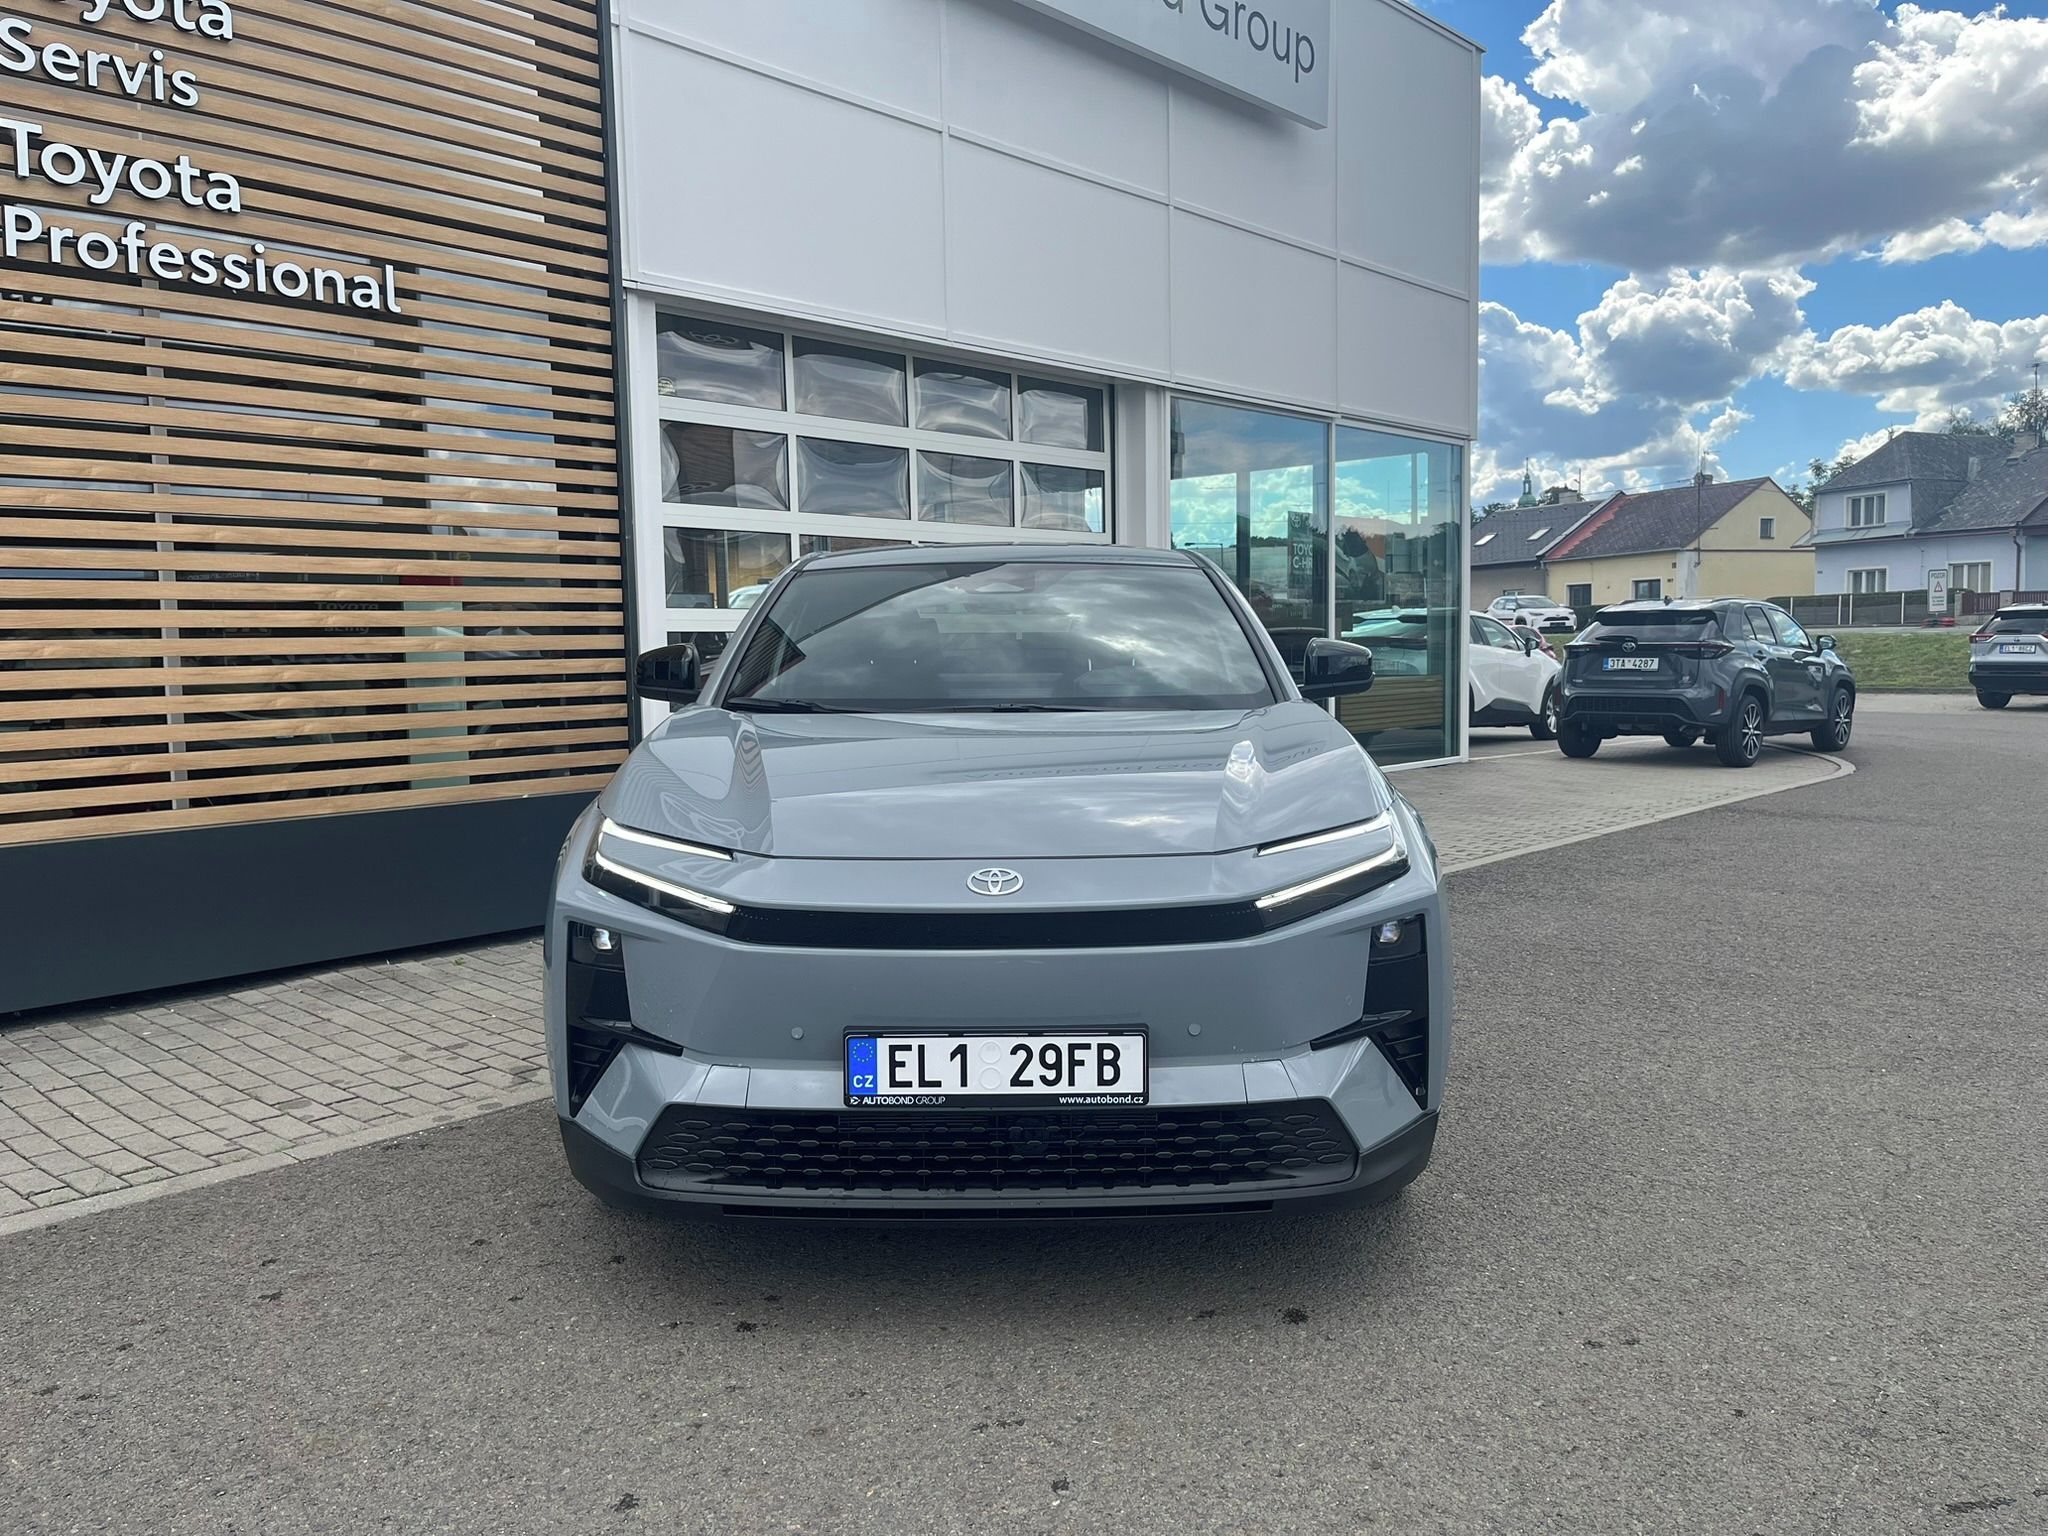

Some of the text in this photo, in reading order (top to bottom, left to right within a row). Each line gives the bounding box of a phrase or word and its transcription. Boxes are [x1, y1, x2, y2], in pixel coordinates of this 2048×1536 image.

[0, 17, 199, 107] Servis
[0, 117, 241, 214] Toyota
[4, 204, 402, 313] Professional
[1609, 658, 1655, 668] 3TA 4287
[888, 1043, 1122, 1088] EL1 29FB
[852, 1075, 874, 1088] CZ
[862, 1096, 946, 1105] AUTOBOND GROUP
[1058, 1094, 1144, 1104] www.autobond.cz
